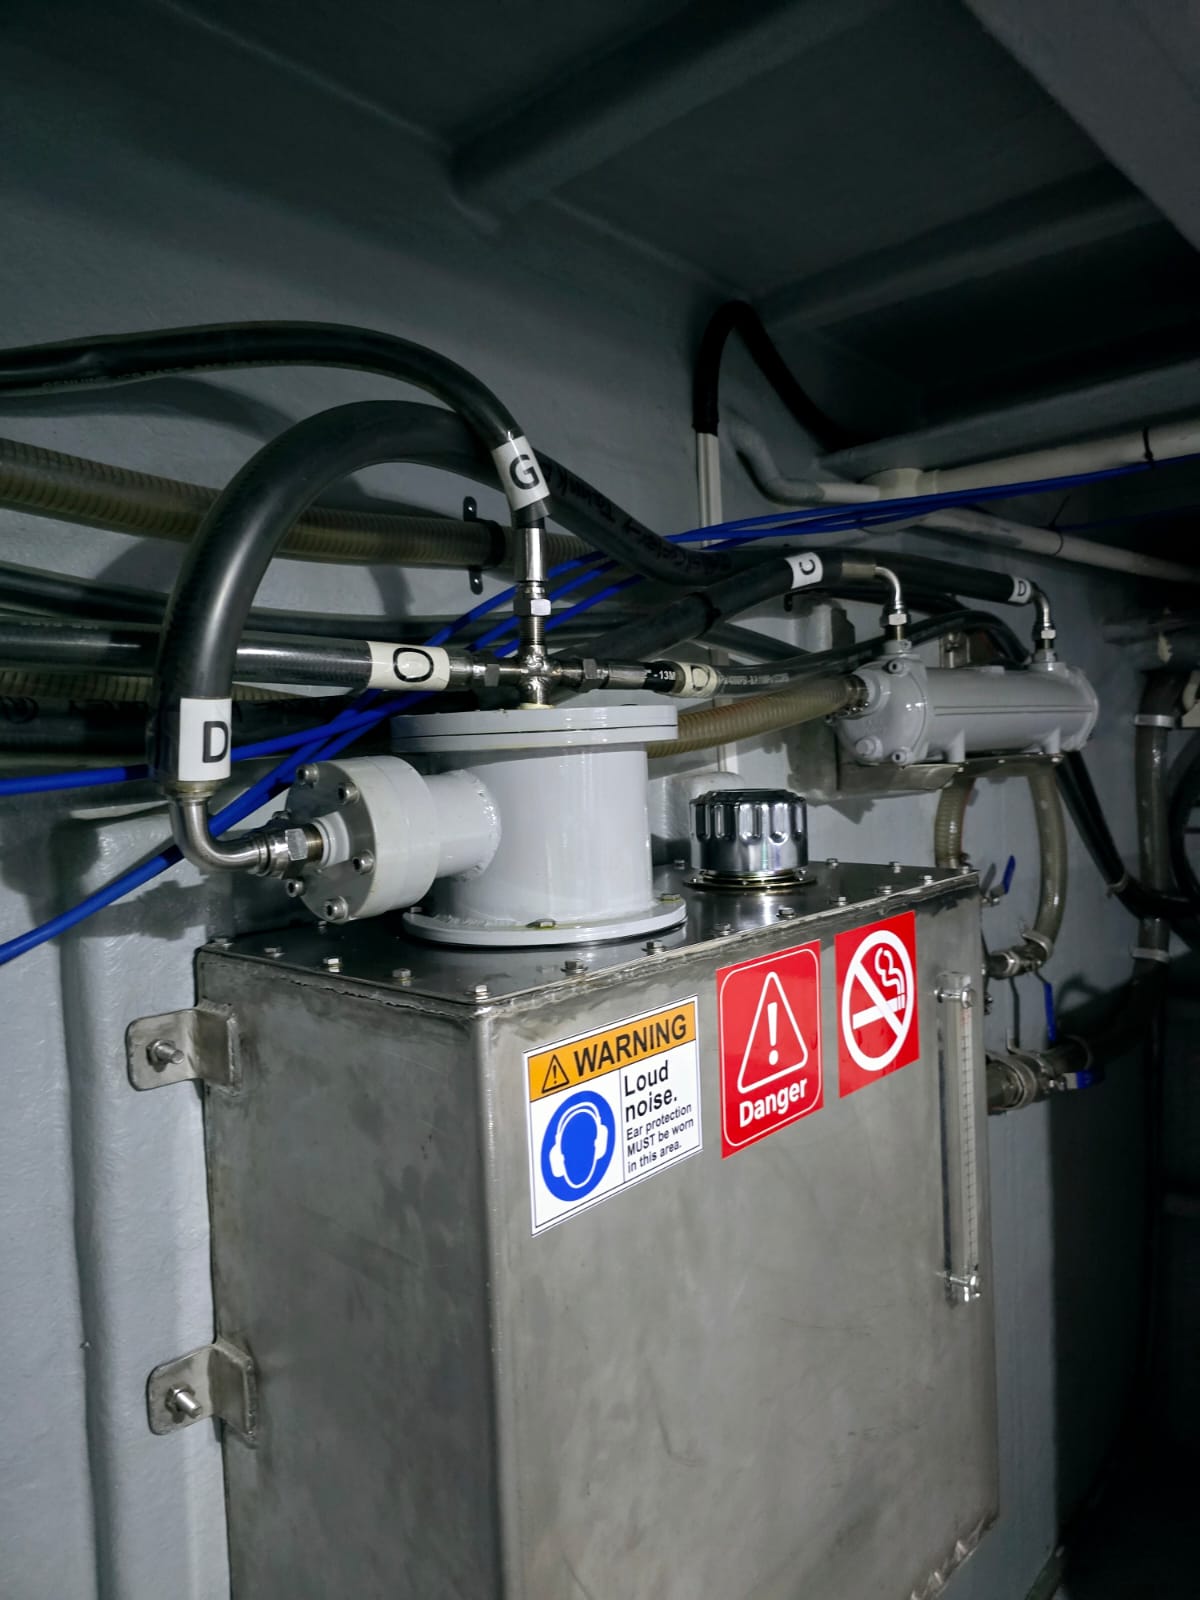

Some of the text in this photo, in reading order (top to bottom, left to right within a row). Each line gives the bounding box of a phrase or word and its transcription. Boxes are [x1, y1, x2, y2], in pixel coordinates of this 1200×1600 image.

[509, 454, 540, 490] G
[1017, 580, 1027, 597] D
[202, 720, 231, 764] D
[574, 1014, 686, 1077] WARNING
[624, 1060, 669, 1097] Loud
[625, 1089, 677, 1123] noise.
[738, 1077, 808, 1128] Danger
[626, 1104, 692, 1141] Ear protection
[627, 1118, 694, 1157] MUST be worn
[628, 1141, 682, 1174] in this area.
